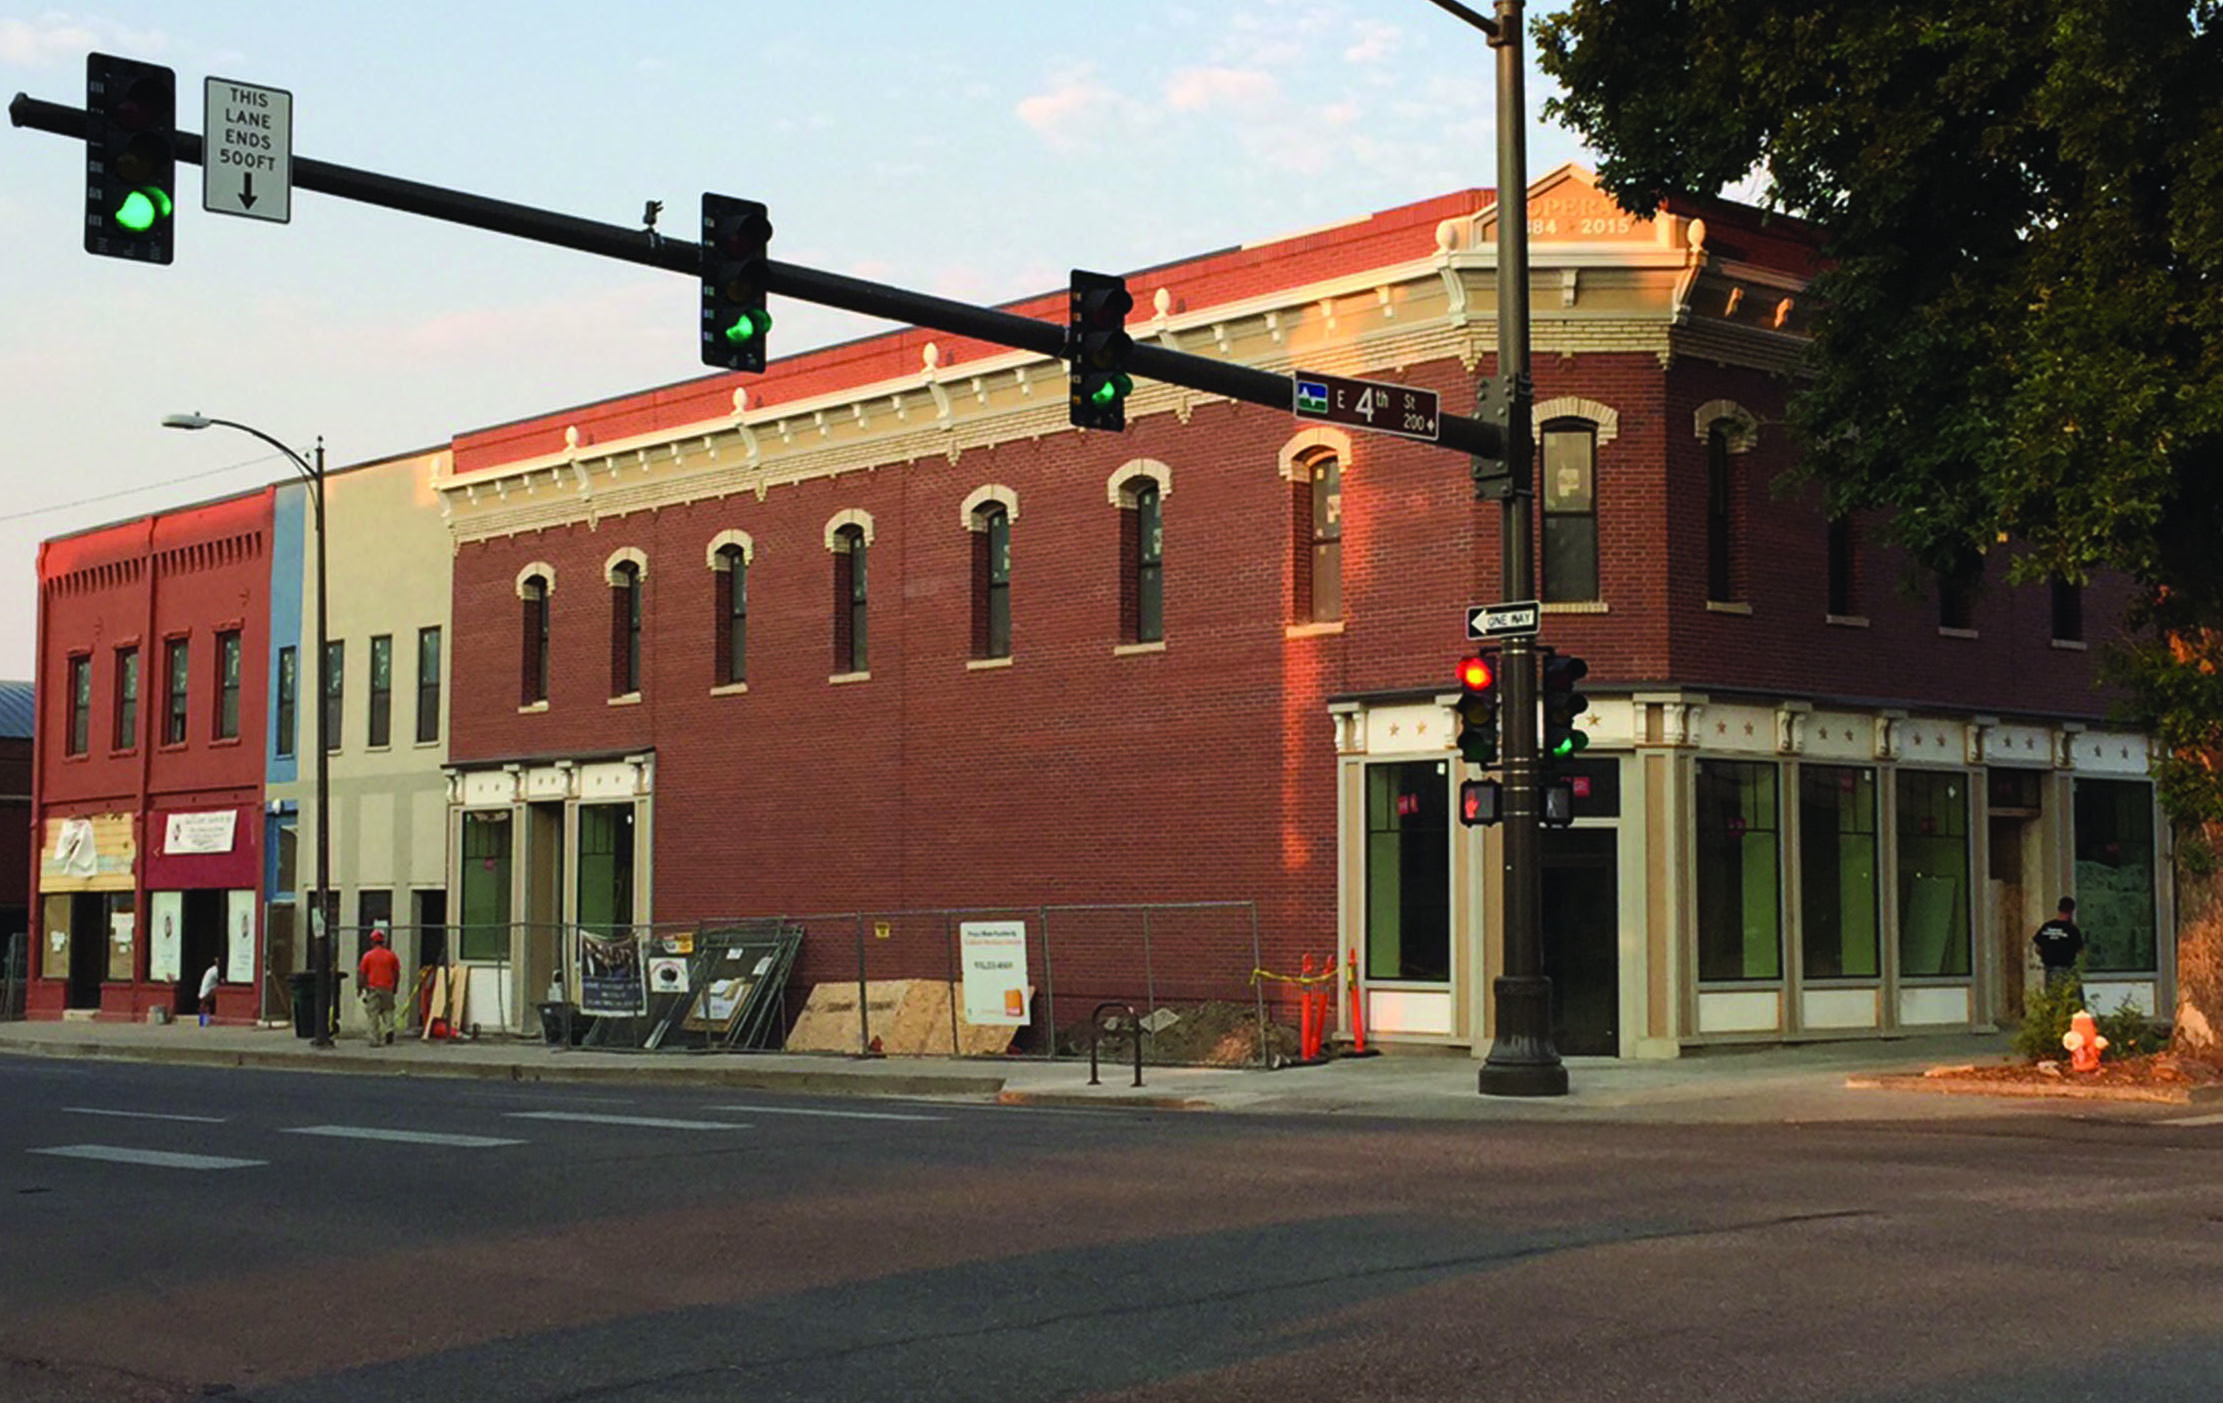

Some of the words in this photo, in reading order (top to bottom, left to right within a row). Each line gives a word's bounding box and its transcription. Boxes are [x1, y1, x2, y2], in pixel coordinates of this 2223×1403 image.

[230, 87, 268, 108] THIS
[225, 107, 271, 130] LANE
[225, 128, 271, 150] ENDS
[219, 148, 275, 171] 500FT
[1581, 218, 1629, 235] 2015
[1337, 389, 1345, 409] E
[1355, 386, 1389, 422] 4th
[1403, 393, 1416, 410] St
[1403, 413, 1424, 431] 200
[1488, 614, 1508, 628] ONE
[1511, 613, 1530, 625] WAY
